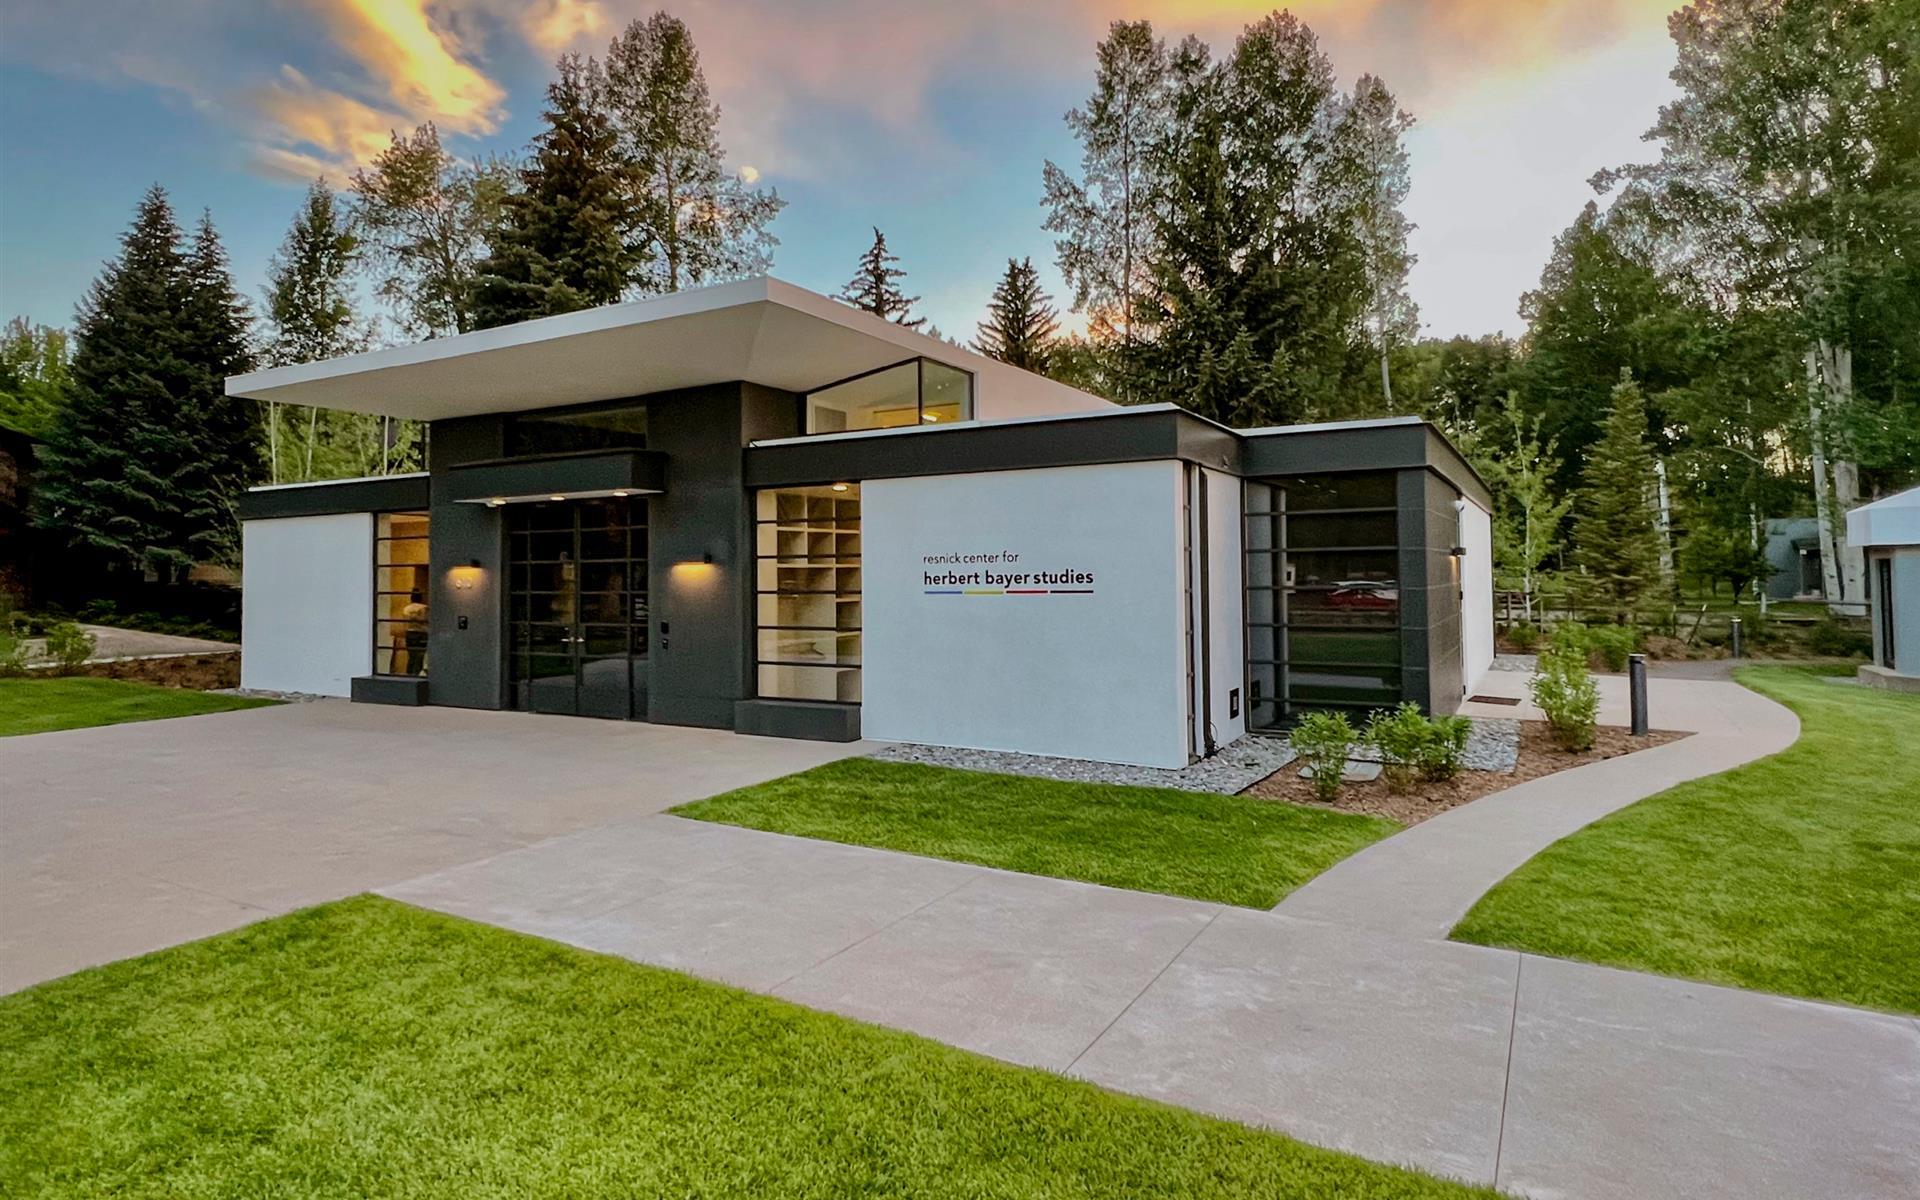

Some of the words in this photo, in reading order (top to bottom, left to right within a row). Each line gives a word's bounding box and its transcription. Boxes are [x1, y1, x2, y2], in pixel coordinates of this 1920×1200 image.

[923, 552, 961, 564] resnick
[963, 553, 999, 564] center
[1002, 550, 1019, 563] for
[924, 571, 980, 585] herbert
[985, 570, 1030, 588] bayer
[1033, 569, 1094, 584] studies
